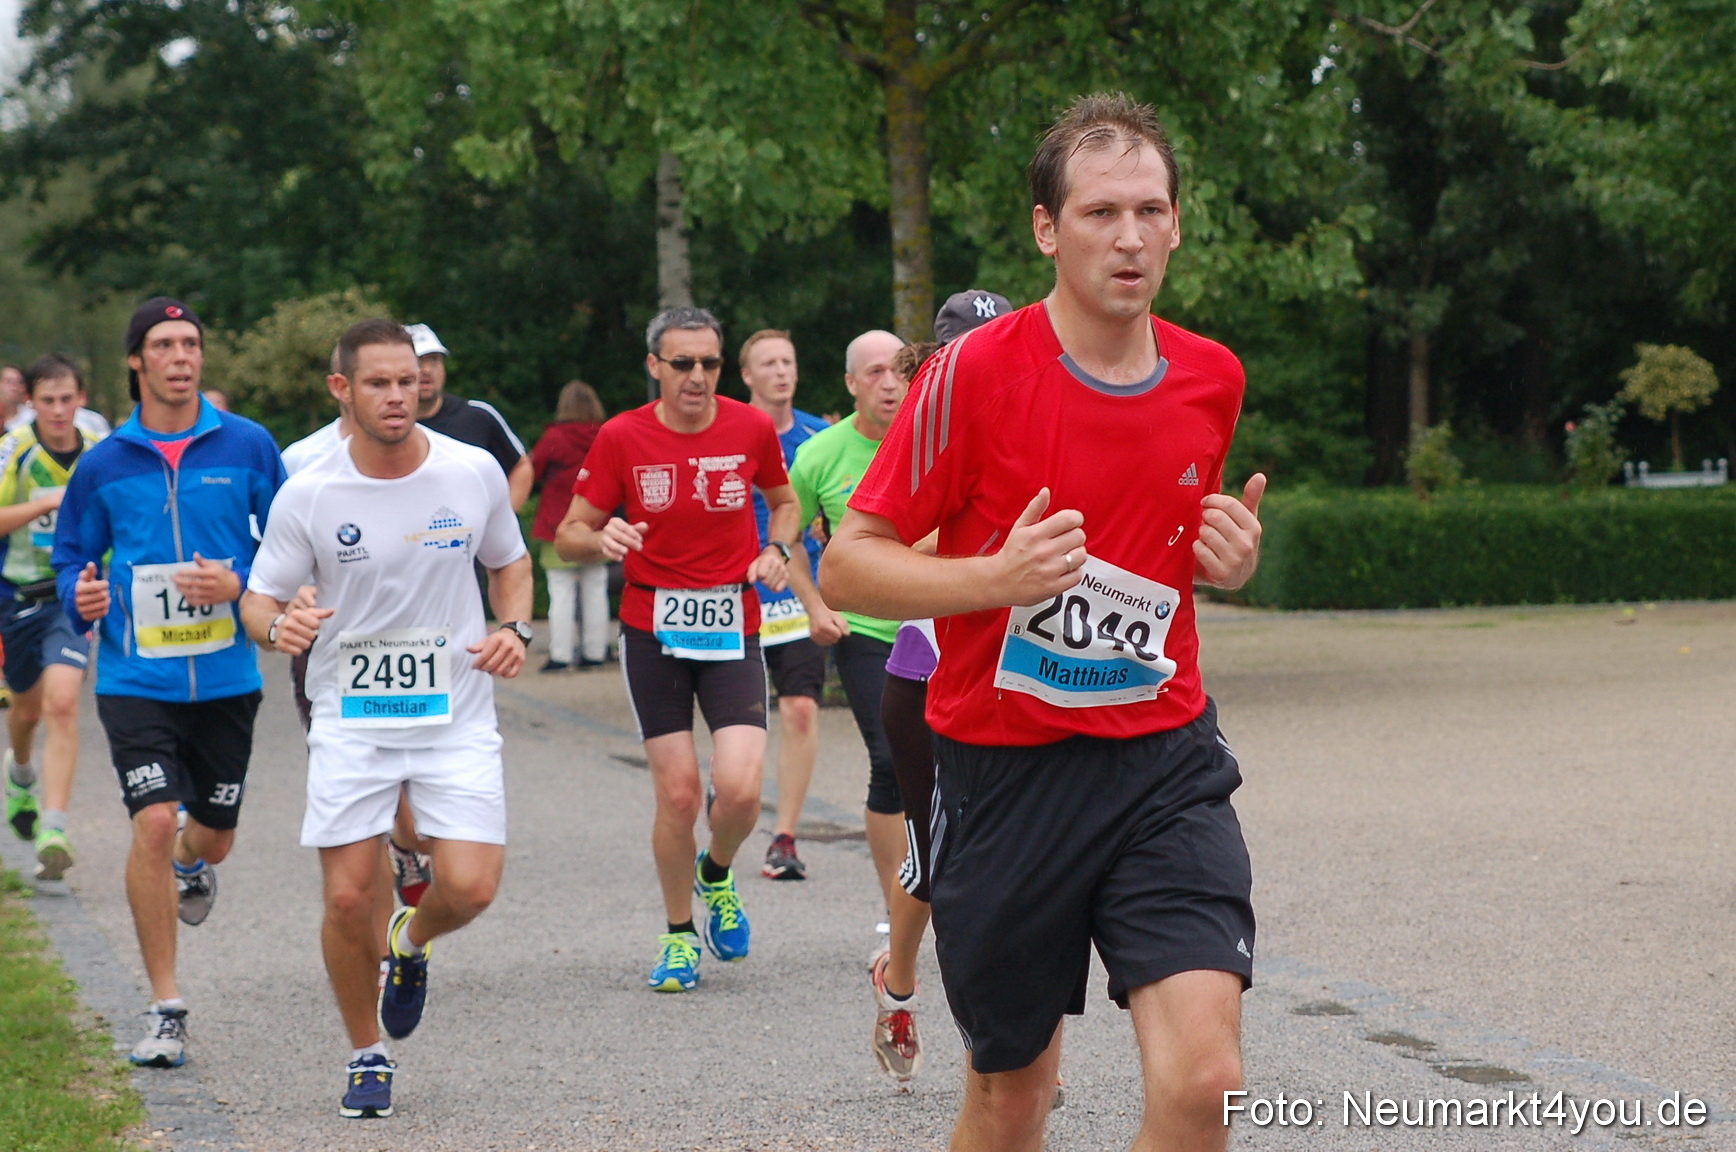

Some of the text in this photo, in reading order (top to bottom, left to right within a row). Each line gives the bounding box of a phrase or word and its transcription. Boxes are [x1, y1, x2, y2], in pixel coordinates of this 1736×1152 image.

[1081, 574, 1151, 613] Neumarkt
[664, 597, 734, 627] 2963
[162, 626, 212, 642] Michael
[379, 638, 430, 648] Neumarkt
[351, 653, 435, 690] 2491
[1038, 656, 1129, 687] Matthias
[363, 700, 428, 715] Christian
[208, 782, 240, 806] 33
